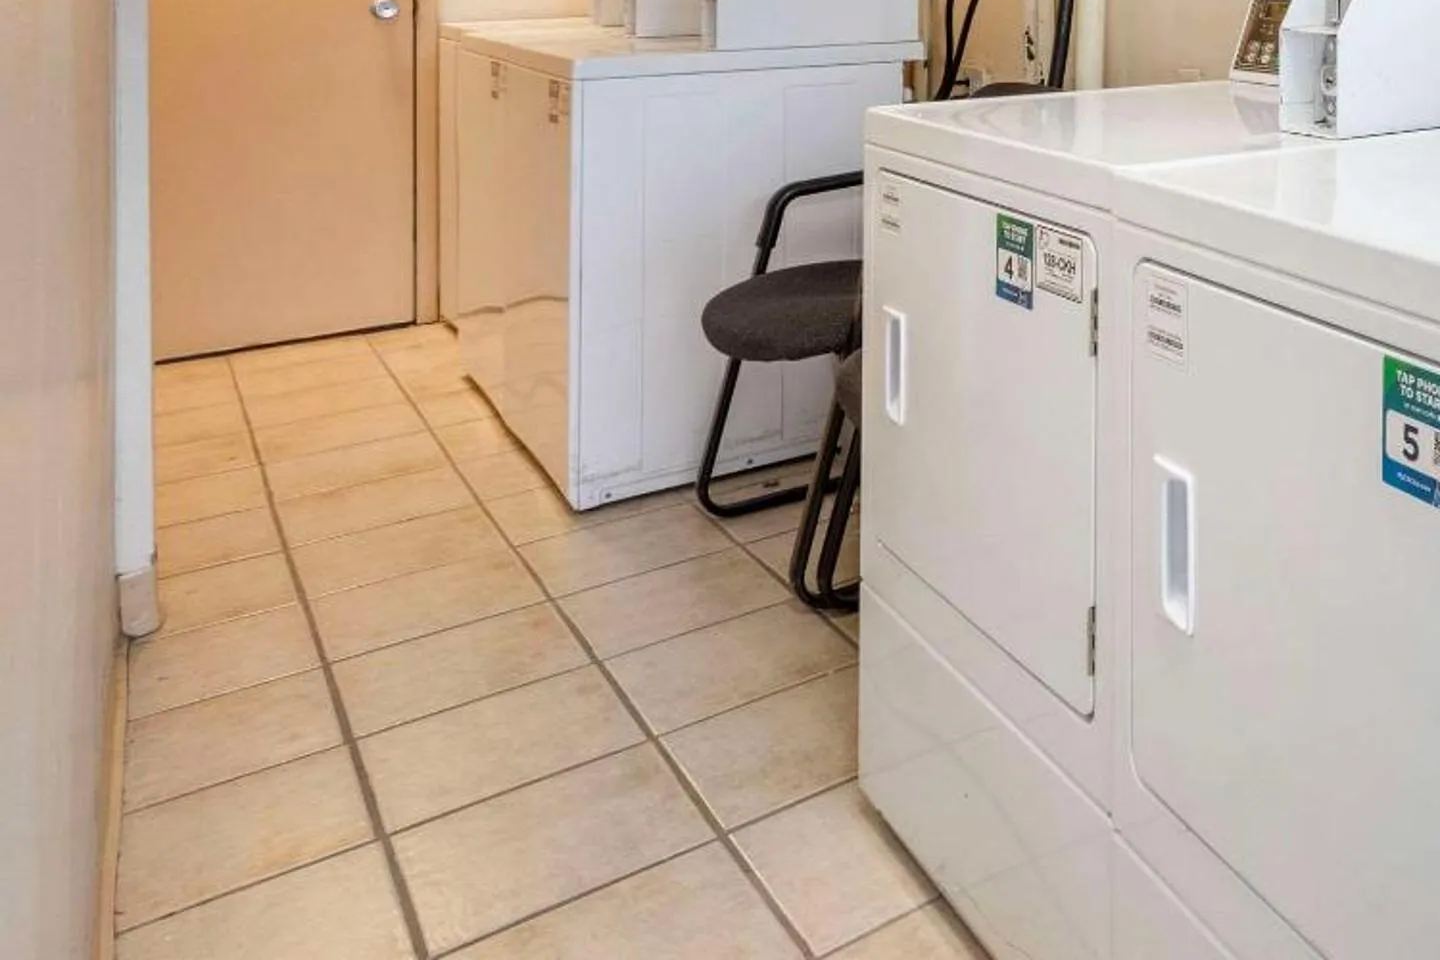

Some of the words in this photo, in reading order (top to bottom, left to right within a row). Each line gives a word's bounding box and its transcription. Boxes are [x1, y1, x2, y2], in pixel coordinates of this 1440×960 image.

[1004, 256, 1014, 280] 4
[1396, 369, 1415, 385] TAP
[1400, 384, 1414, 399] TO
[1403, 423, 1419, 462] 5
